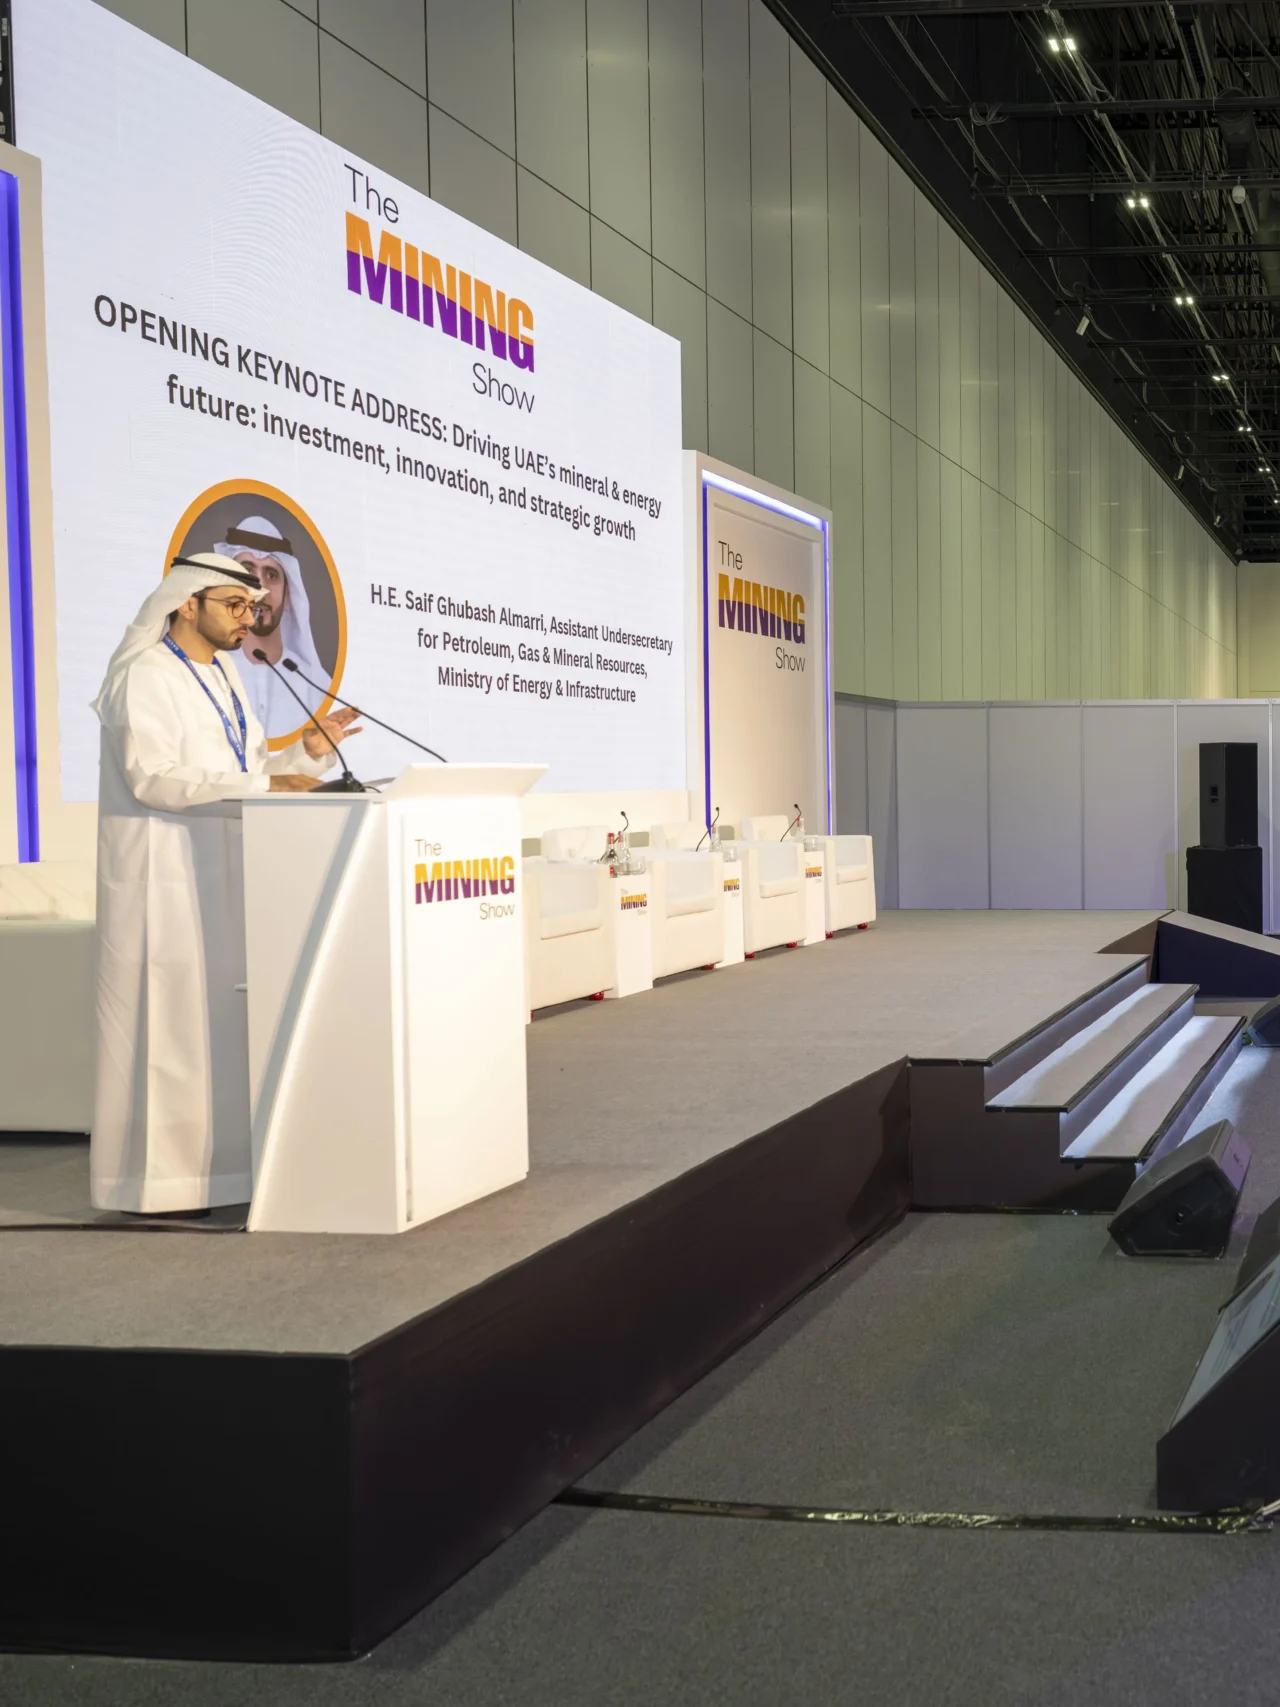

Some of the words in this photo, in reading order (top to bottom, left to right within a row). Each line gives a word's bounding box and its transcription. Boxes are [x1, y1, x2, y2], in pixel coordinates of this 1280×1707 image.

[344, 163, 399, 224] The
[345, 210, 535, 373] MINING
[94, 294, 230, 368] OPENING
[237, 345, 346, 408] KEYNOTE
[351, 388, 448, 443] ADDRESS:
[452, 423, 511, 470] Driving
[559, 465, 609, 498] mineral
[611, 480, 620, 500] &
[622, 489, 662, 519] energy
[472, 362, 535, 413] Show
[167, 374, 256, 428] future:
[263, 404, 390, 475] investment,
[396, 447, 494, 504] innovation,
[498, 485, 527, 510] and
[530, 495, 590, 530] strategic
[593, 515, 636, 541] growth
[718, 540, 743, 570] The
[371, 583, 401, 608] H.E.
[405, 590, 434, 613] Saif
[437, 596, 496, 624] Ghubash
[499, 607, 547, 635] Almarri,
[550, 616, 598, 640] Assistant
[601, 625, 673, 656] Undersecretary
[718, 573, 805, 644] MINING
[417, 628, 438, 649] for
[442, 631, 515, 662] Petroleum,
[518, 643, 540, 662] Gas
[543, 647, 551, 664] &
[553, 648, 593, 670] Mineral
[596, 654, 648, 679] Resources,
[775, 647, 806, 672] Show
[438, 666, 493, 694] Ministry
[496, 673, 509, 691] of
[513, 675, 553, 700] Energy
[555, 680, 564, 696] &
[565, 680, 636, 702] Infrastructure
[415, 838, 442, 856] The
[415, 856, 515, 904] MINING
[621, 893, 648, 911] MINING
[480, 902, 515, 920] Show
